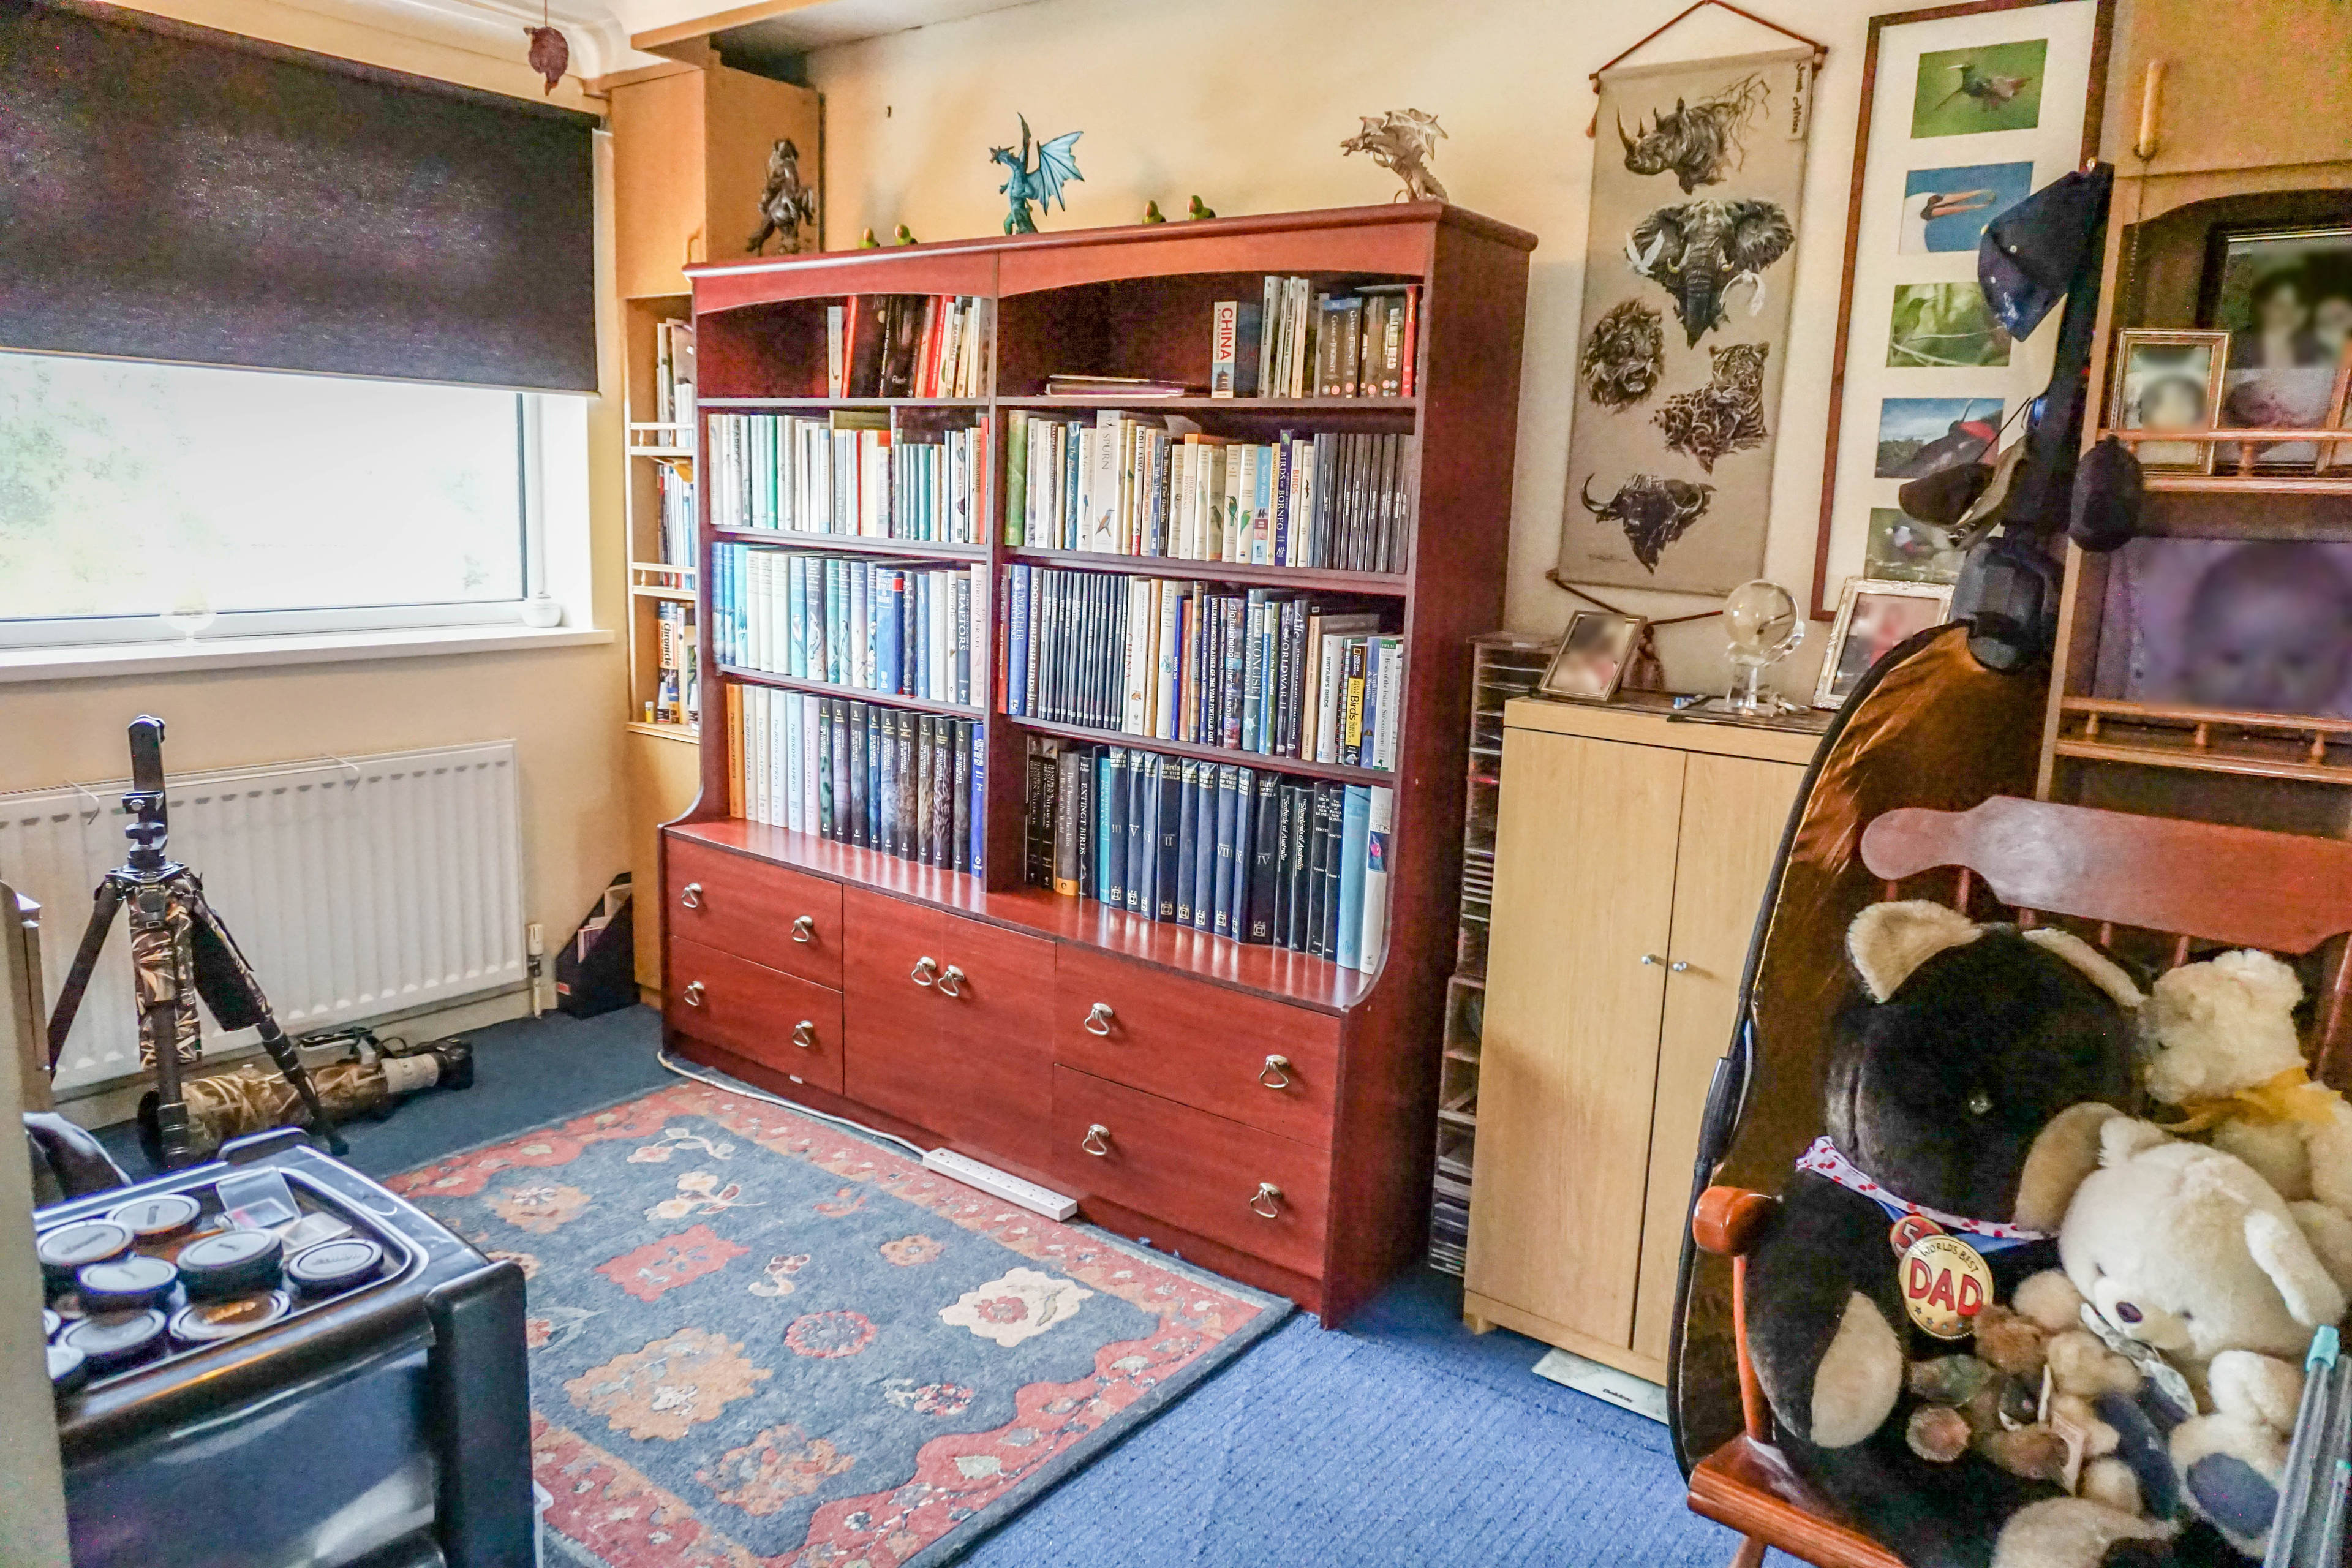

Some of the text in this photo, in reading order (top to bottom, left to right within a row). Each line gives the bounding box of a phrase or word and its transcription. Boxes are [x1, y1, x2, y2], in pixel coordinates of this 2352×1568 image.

[1220, 307, 1233, 361] CHINA
[1331, 315, 1340, 336] GAME
[1349, 311, 1358, 332] GAME
[1102, 433, 1110, 470] SPURN
[1276, 489, 1286, 531] BORNEO
[1016, 595, 1025, 641] WEATHER
[1030, 606, 1038, 620] OF
[1294, 619, 1303, 638] Life
[663, 622, 673, 667] Chronicle
[1029, 621, 1038, 660] BRITISH
[1124, 633, 1133, 679] CHINA
[1245, 609, 1253, 692] ENCYCLOPEDIA
[1251, 640, 1262, 693] CONCISE
[1349, 695, 1360, 720] Birds
[1379, 710, 1388, 747] Subcontinent
[1281, 799, 1290, 824] Seabirds
[1298, 803, 1307, 835] Shorebirds
[1129, 827, 1139, 837] V
[1164, 837, 1172, 846] II
[1257, 856, 1270, 865] IV
[1958, 1251, 1979, 1272] BEST
[1909, 1257, 1984, 1316] DAD
